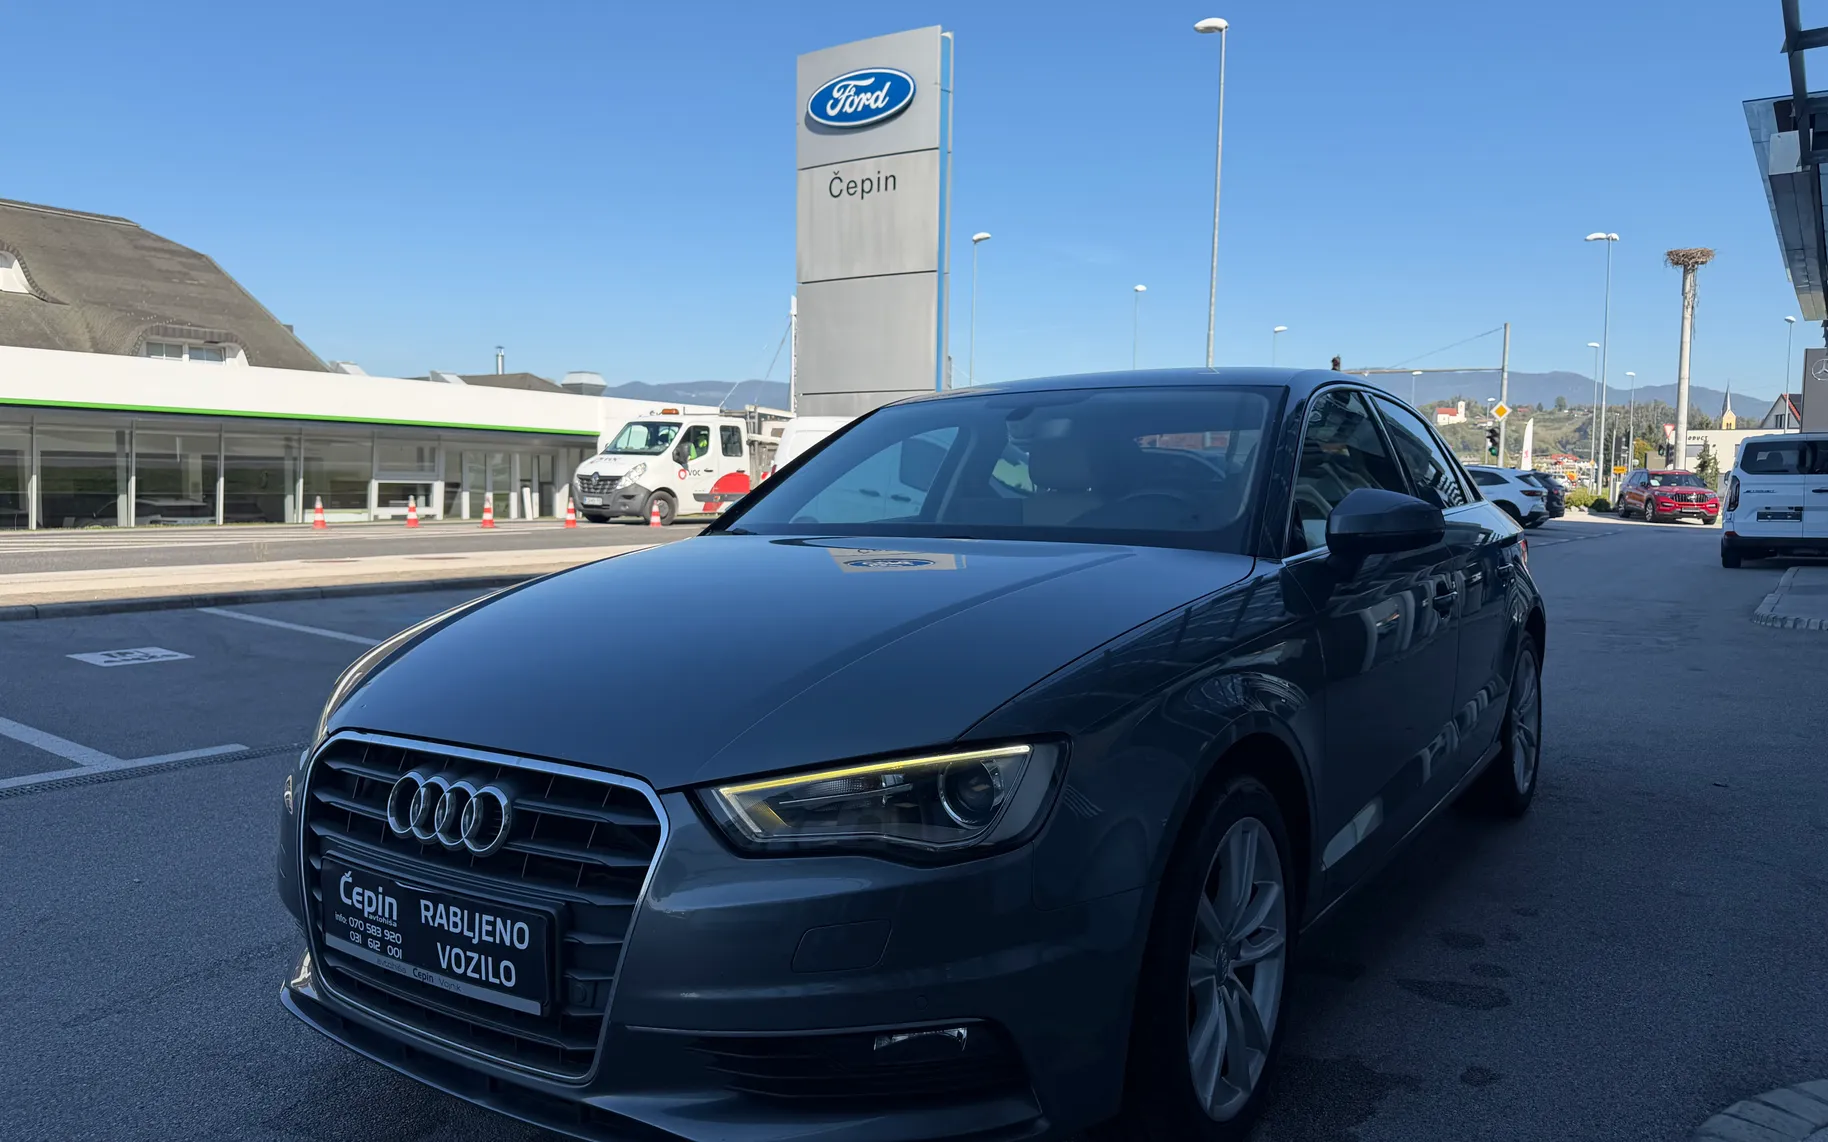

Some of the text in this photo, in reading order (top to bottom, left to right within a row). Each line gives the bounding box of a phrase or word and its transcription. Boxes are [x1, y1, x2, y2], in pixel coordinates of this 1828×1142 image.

[826, 76, 892, 117] Ford
[828, 170, 897, 200] Čepin
[340, 871, 398, 920] Čepin
[334, 911, 402, 944] info: 070 583 920
[349, 931, 403, 959] 031 612 001
[420, 899, 530, 950] RABLJENO
[437, 942, 516, 987] VOZILO
